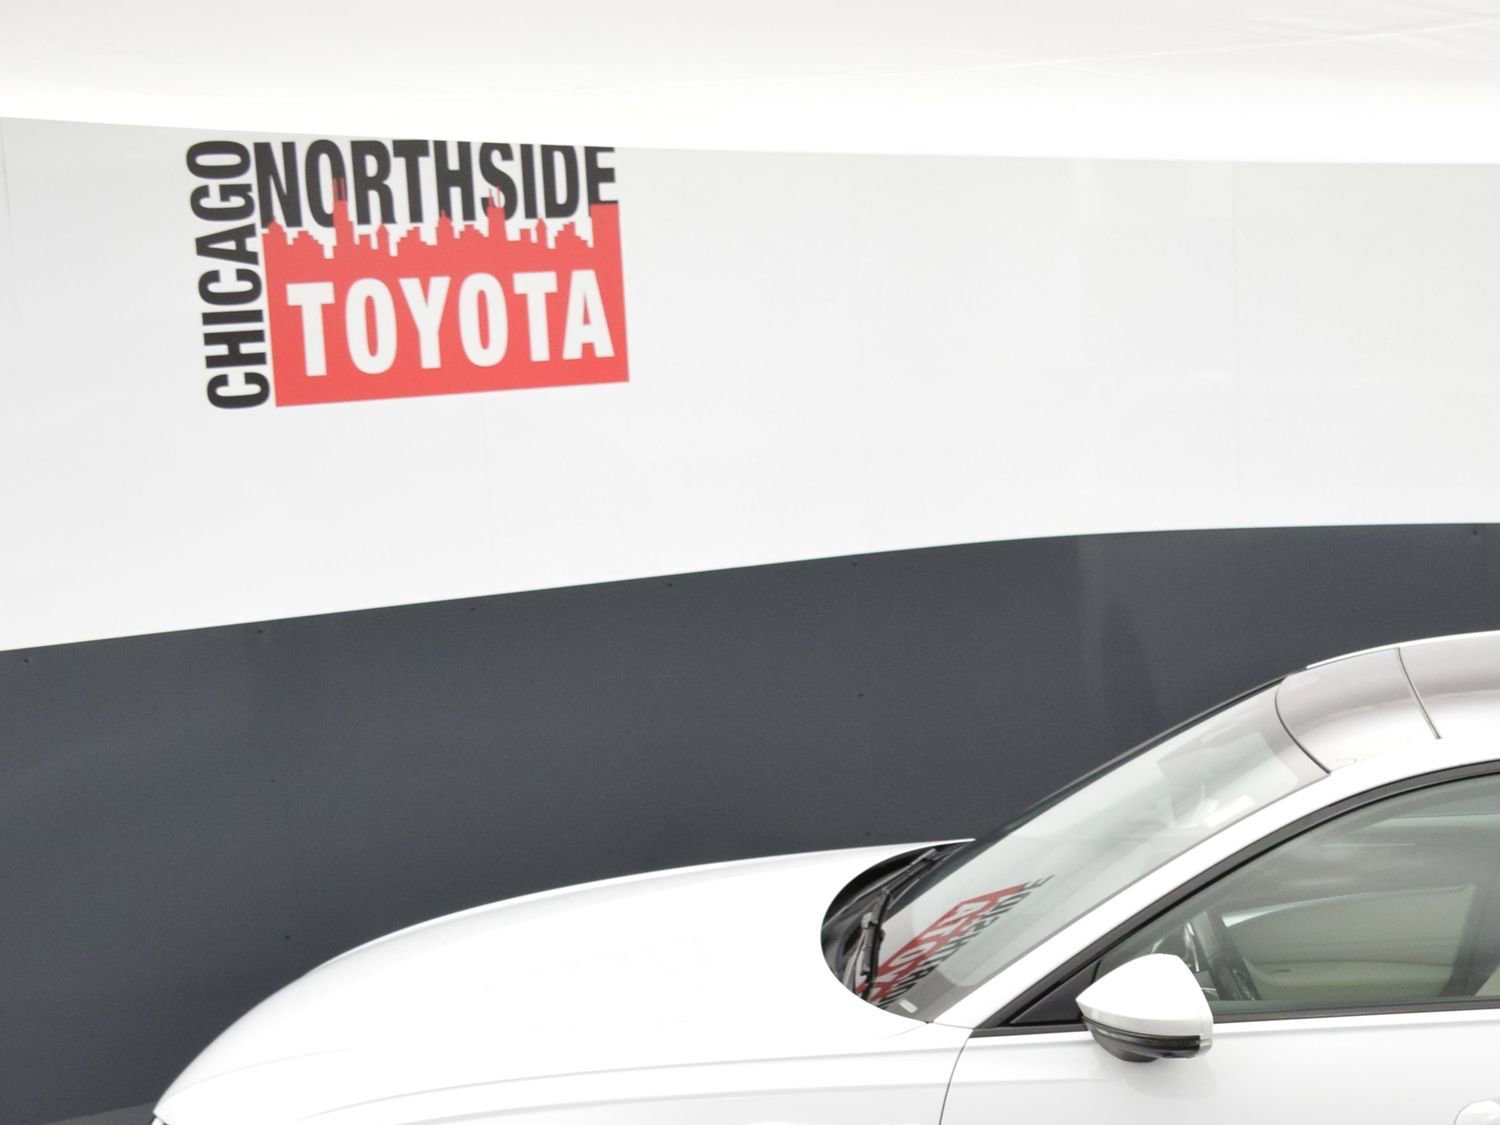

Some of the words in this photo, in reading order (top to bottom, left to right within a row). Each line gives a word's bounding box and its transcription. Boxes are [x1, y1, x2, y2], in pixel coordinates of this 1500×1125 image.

[252, 138, 619, 229] NORTHSIDE
[186, 139, 270, 410] CHICAGO
[286, 269, 615, 377] TOYOTA
